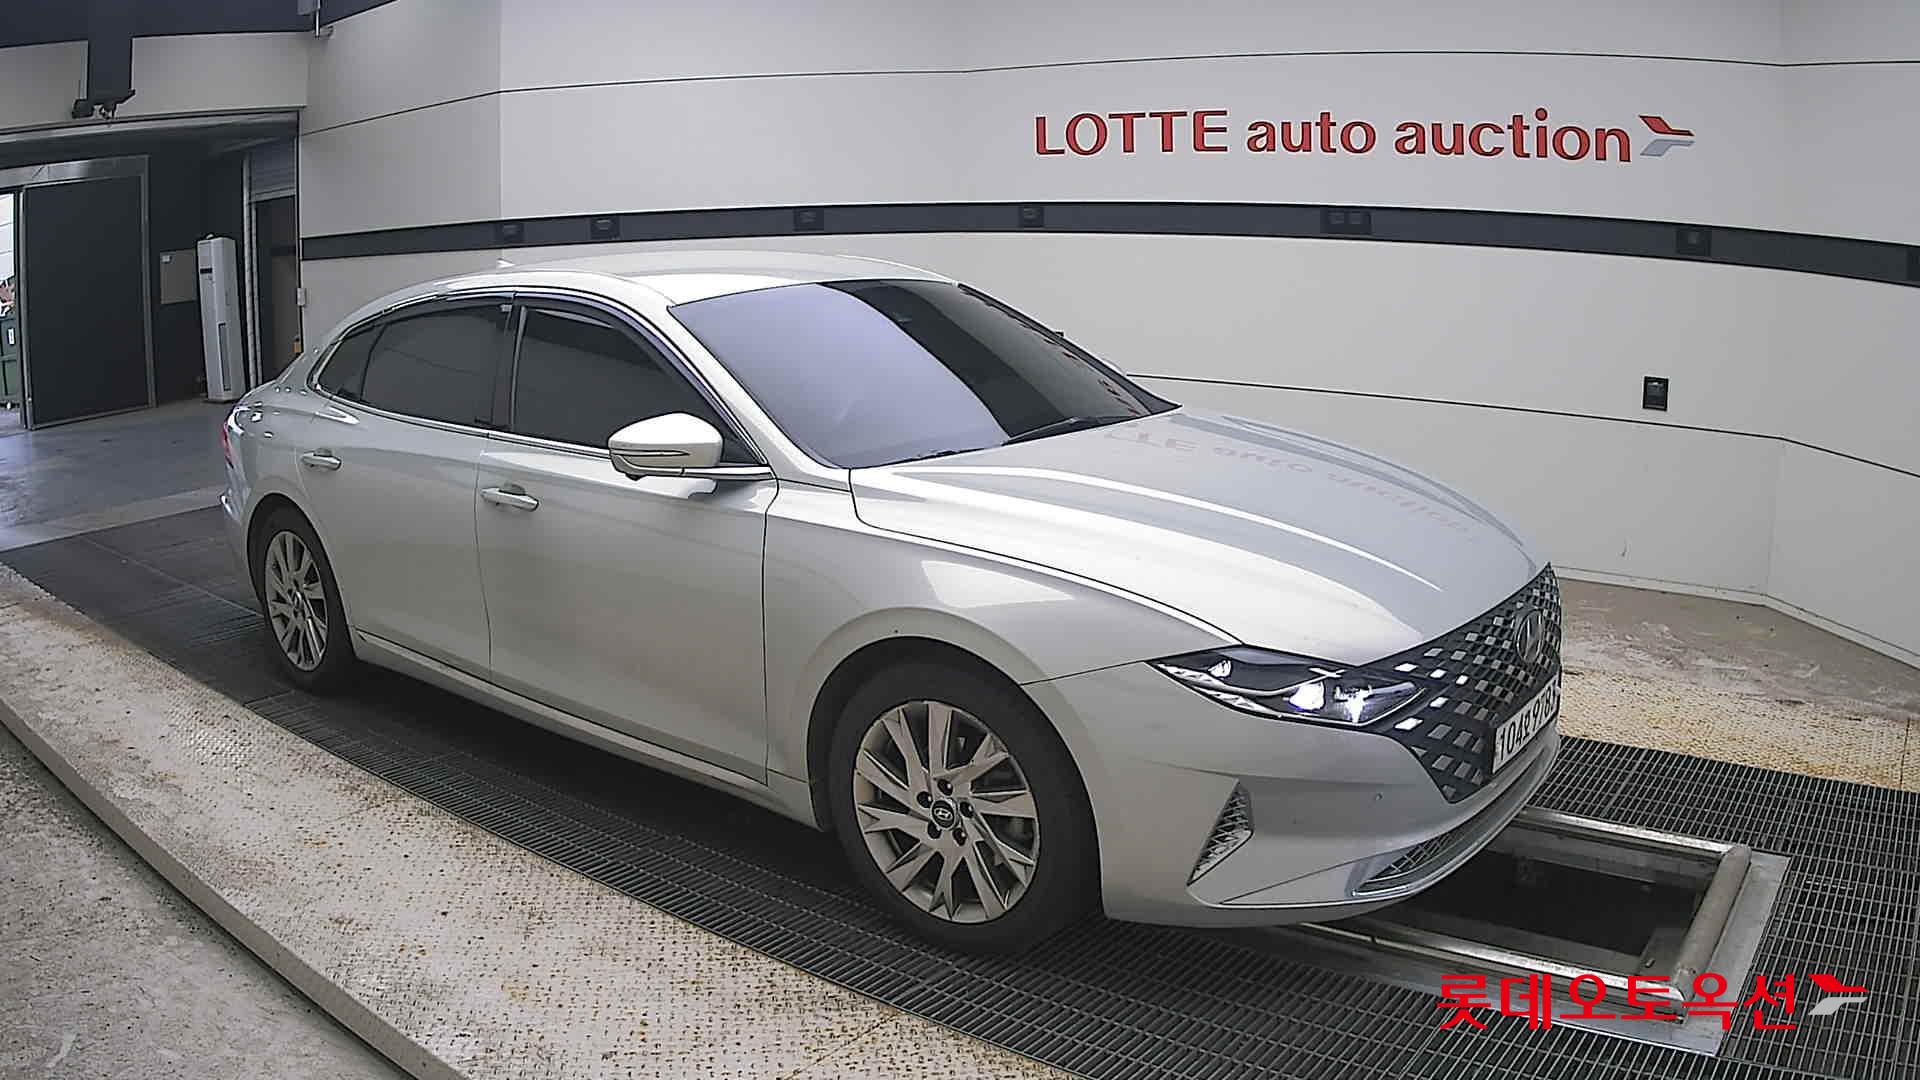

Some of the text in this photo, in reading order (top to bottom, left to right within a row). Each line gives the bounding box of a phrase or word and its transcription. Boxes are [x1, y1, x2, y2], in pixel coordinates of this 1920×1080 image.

[1035, 108, 1632, 162] LOTTE auto auction
